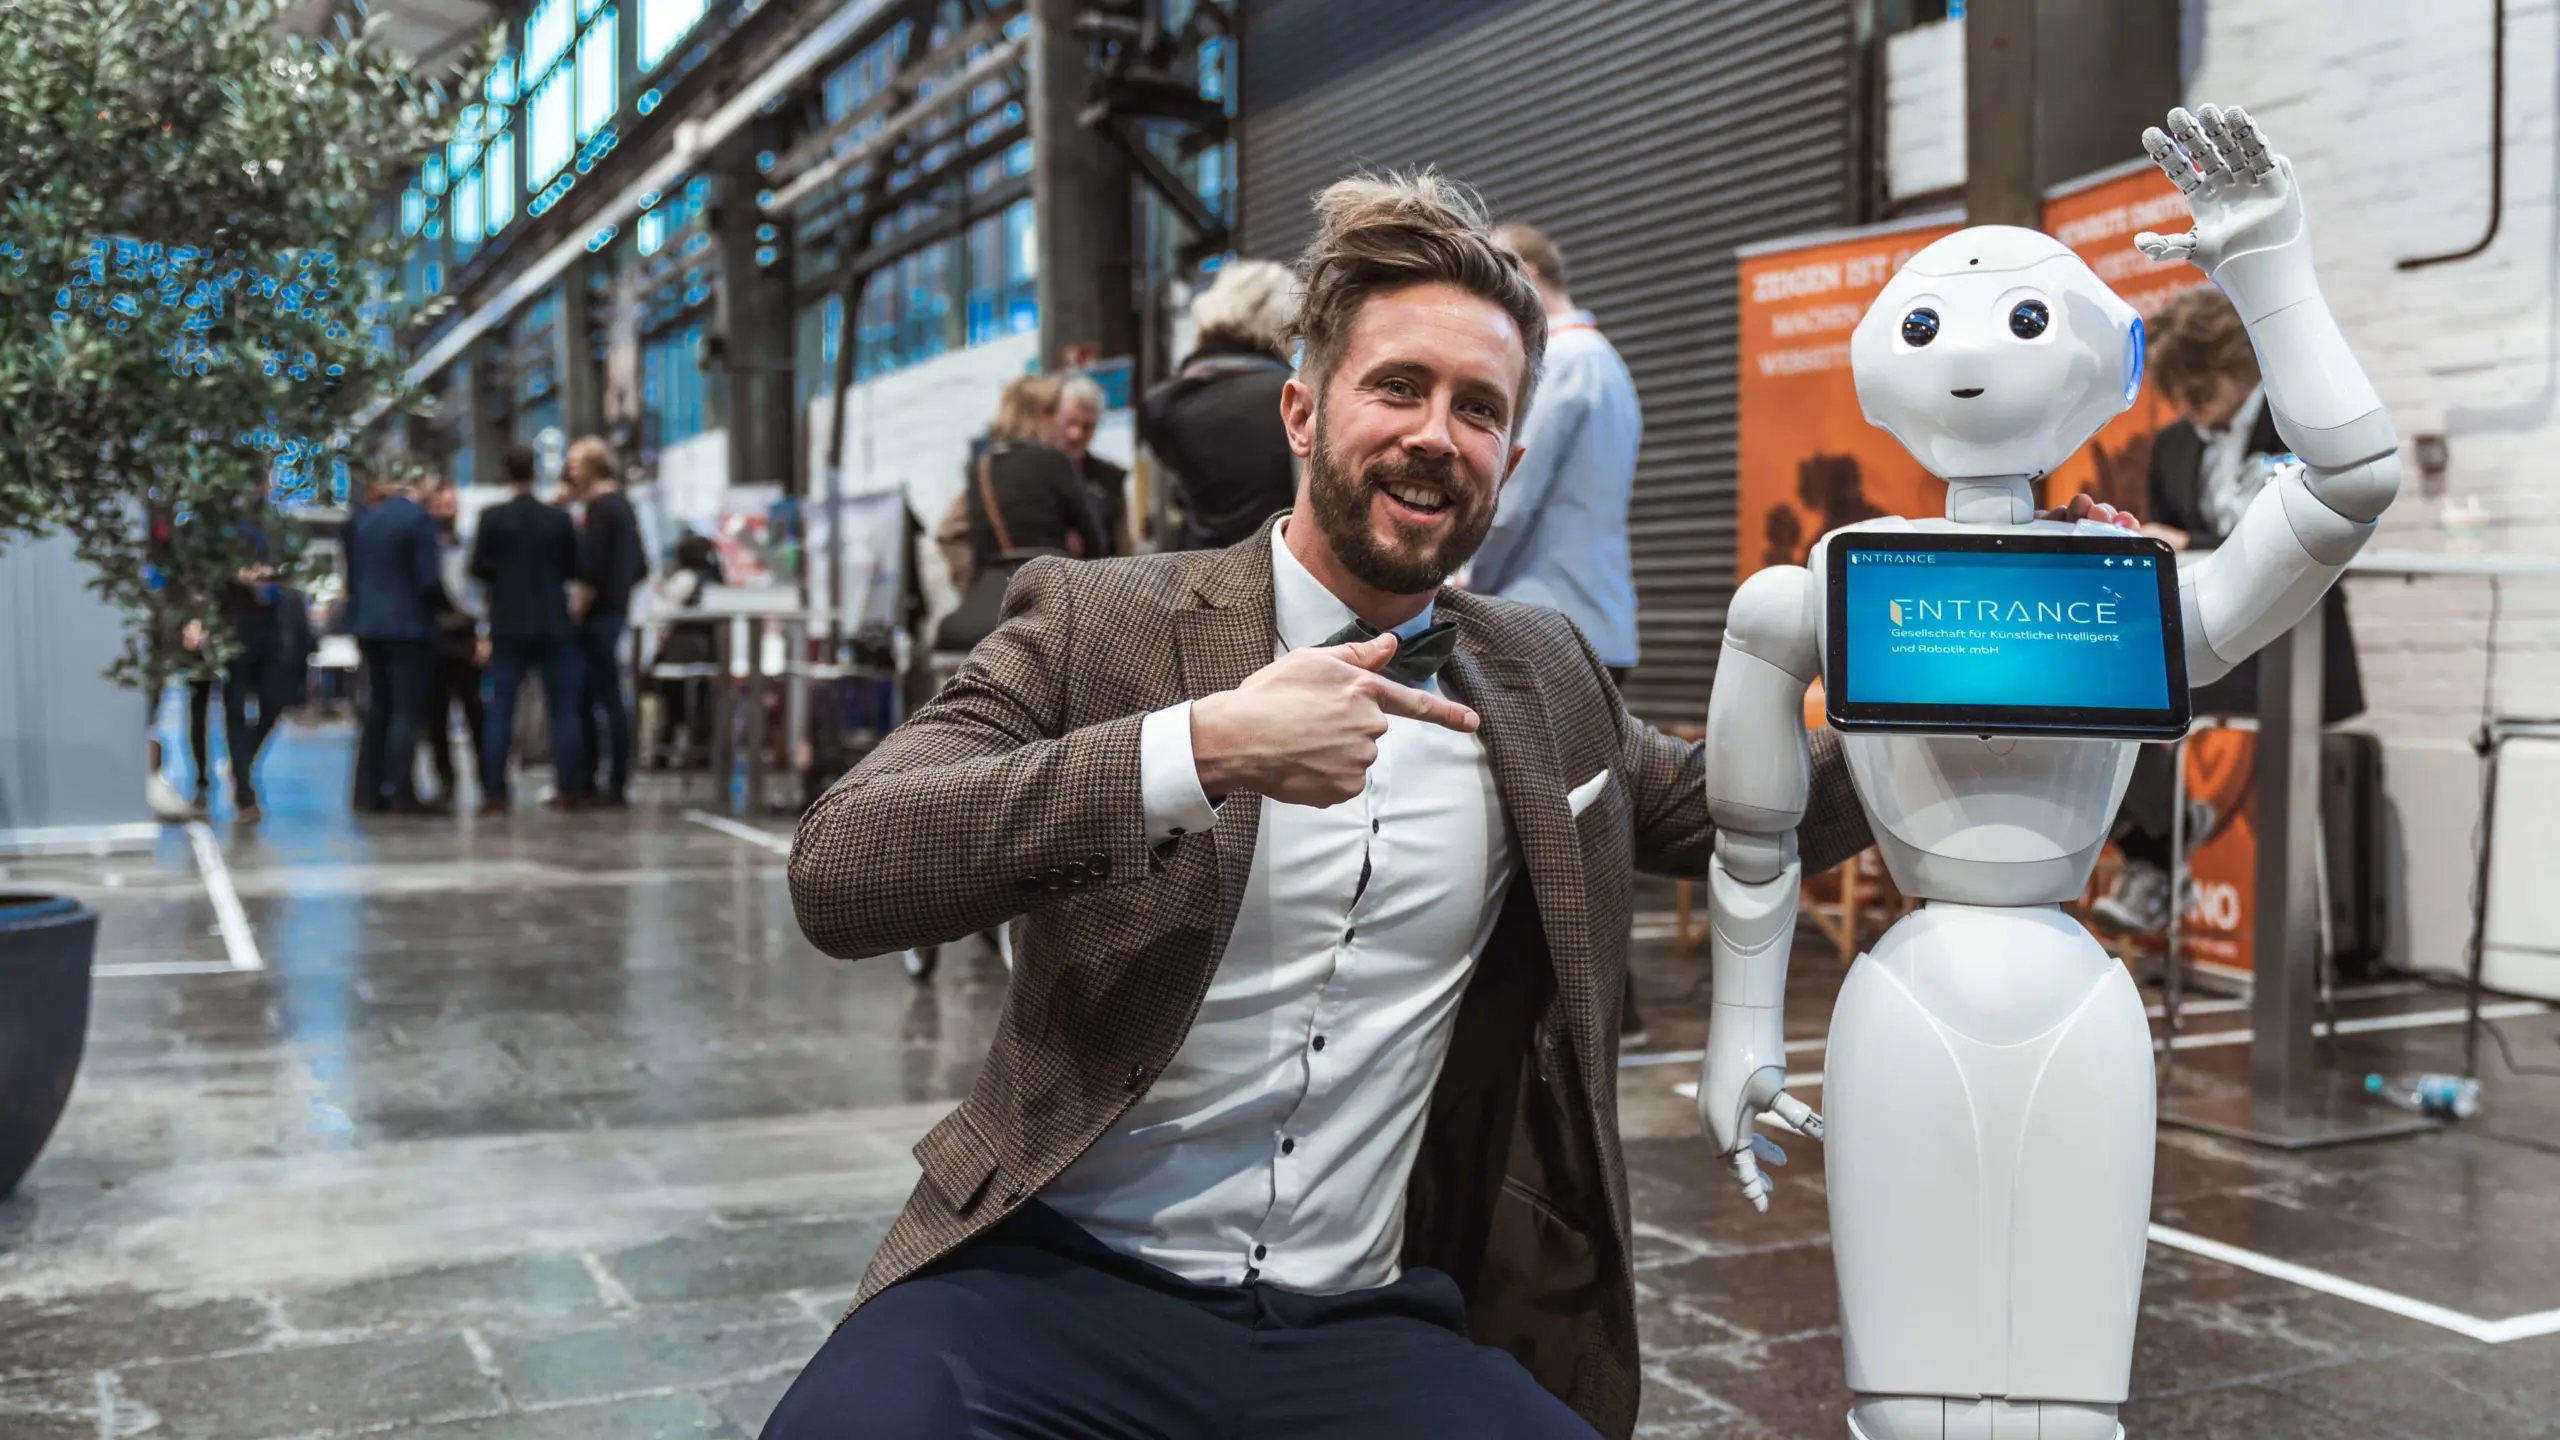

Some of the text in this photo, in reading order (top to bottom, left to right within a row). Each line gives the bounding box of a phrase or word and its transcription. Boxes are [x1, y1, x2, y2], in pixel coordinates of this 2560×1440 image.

[1851, 553, 1936, 564] ENTRANCE
[1890, 599, 2117, 626] ENTRANCE
[1891, 628, 2119, 643] Gesellschaft für Künstliche Intelligenz
[1891, 644, 1999, 655] und Robotik mbH
